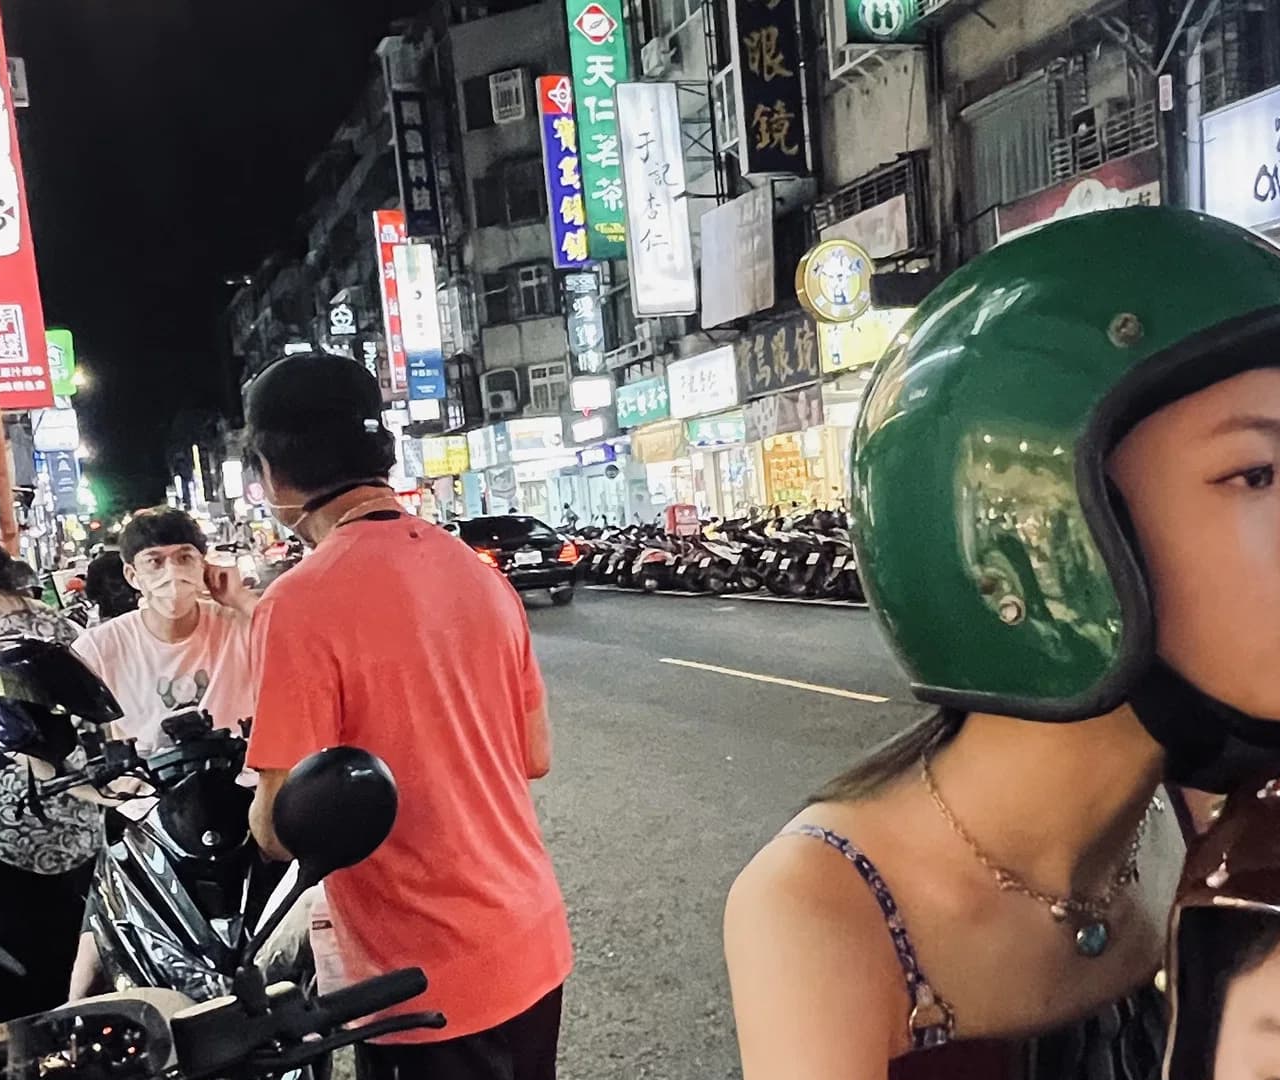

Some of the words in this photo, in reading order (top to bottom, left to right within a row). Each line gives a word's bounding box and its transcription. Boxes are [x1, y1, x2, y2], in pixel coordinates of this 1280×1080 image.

[583, 55, 625, 213] 天仁茗茶
[743, 0, 799, 155] 眼鏡
